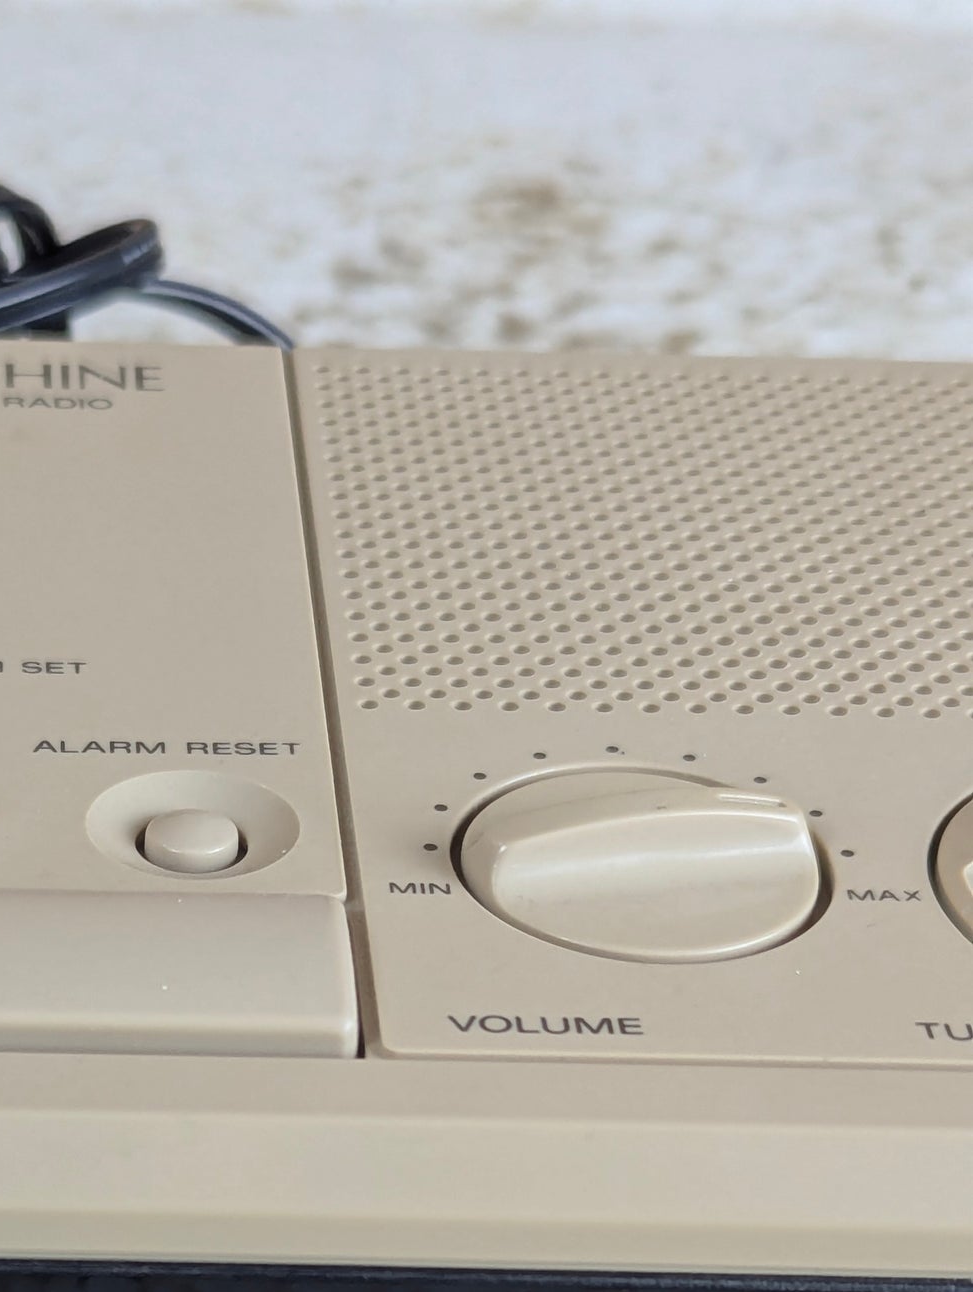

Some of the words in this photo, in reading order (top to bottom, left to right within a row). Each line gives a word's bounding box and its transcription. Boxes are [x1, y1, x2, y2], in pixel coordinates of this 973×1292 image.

[3, 398, 114, 411] RADIO
[22, 662, 87, 675] SET
[33, 740, 166, 755] ALARM
[186, 742, 300, 756] RESET
[388, 881, 451, 896] MIN
[847, 889, 921, 902] MAX
[448, 1015, 645, 1035] VOLUME
